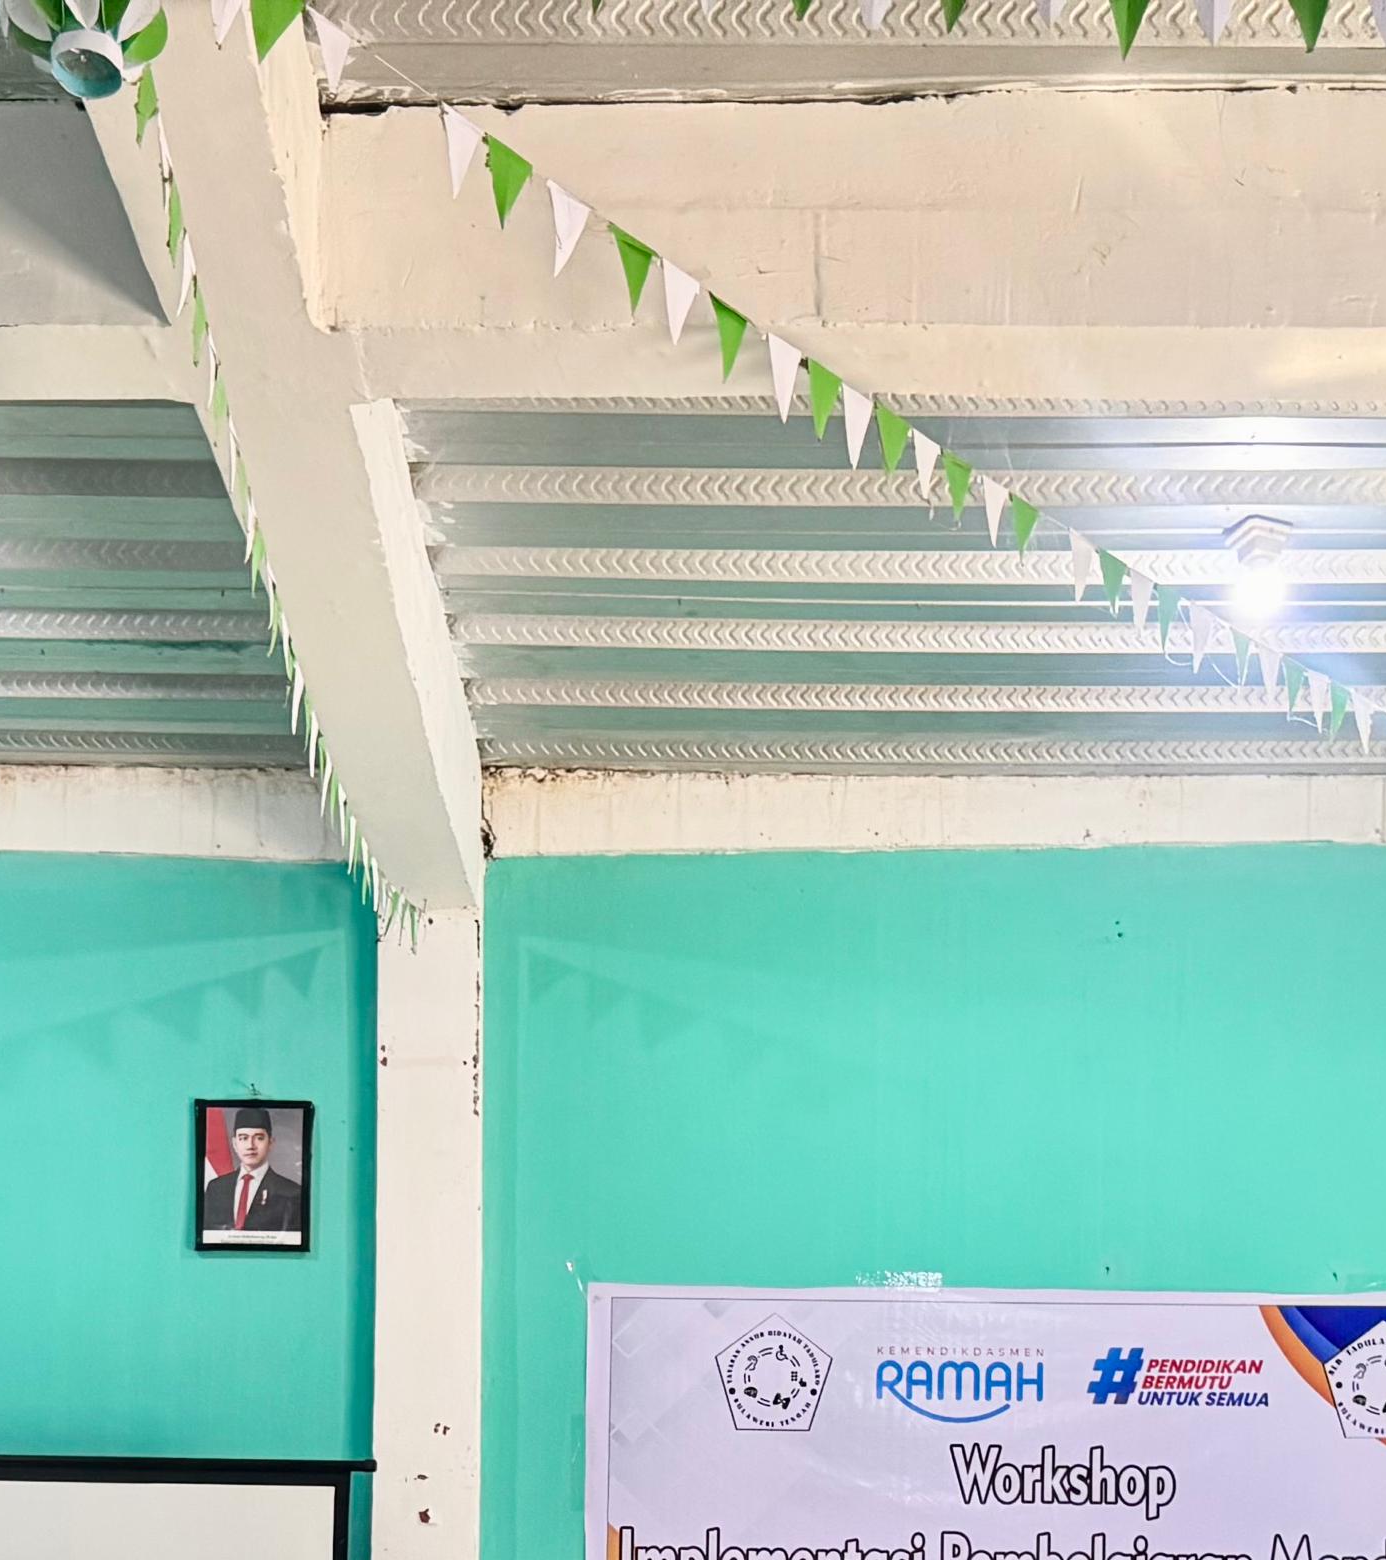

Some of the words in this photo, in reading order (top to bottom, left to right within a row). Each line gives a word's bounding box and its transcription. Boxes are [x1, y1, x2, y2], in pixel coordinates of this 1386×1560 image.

[877, 1346, 1045, 1357] KEMENDIKDASMEN
[1146, 1359, 1264, 1374] PENDIDIKAN
[1141, 1375, 1233, 1390] BERMUTU
[876, 1360, 1044, 1423] RAMAH
[1138, 1391, 1203, 1406] UNTUK
[1205, 1392, 1269, 1407] SEMUA
[950, 1443, 1176, 1521] Workshop
